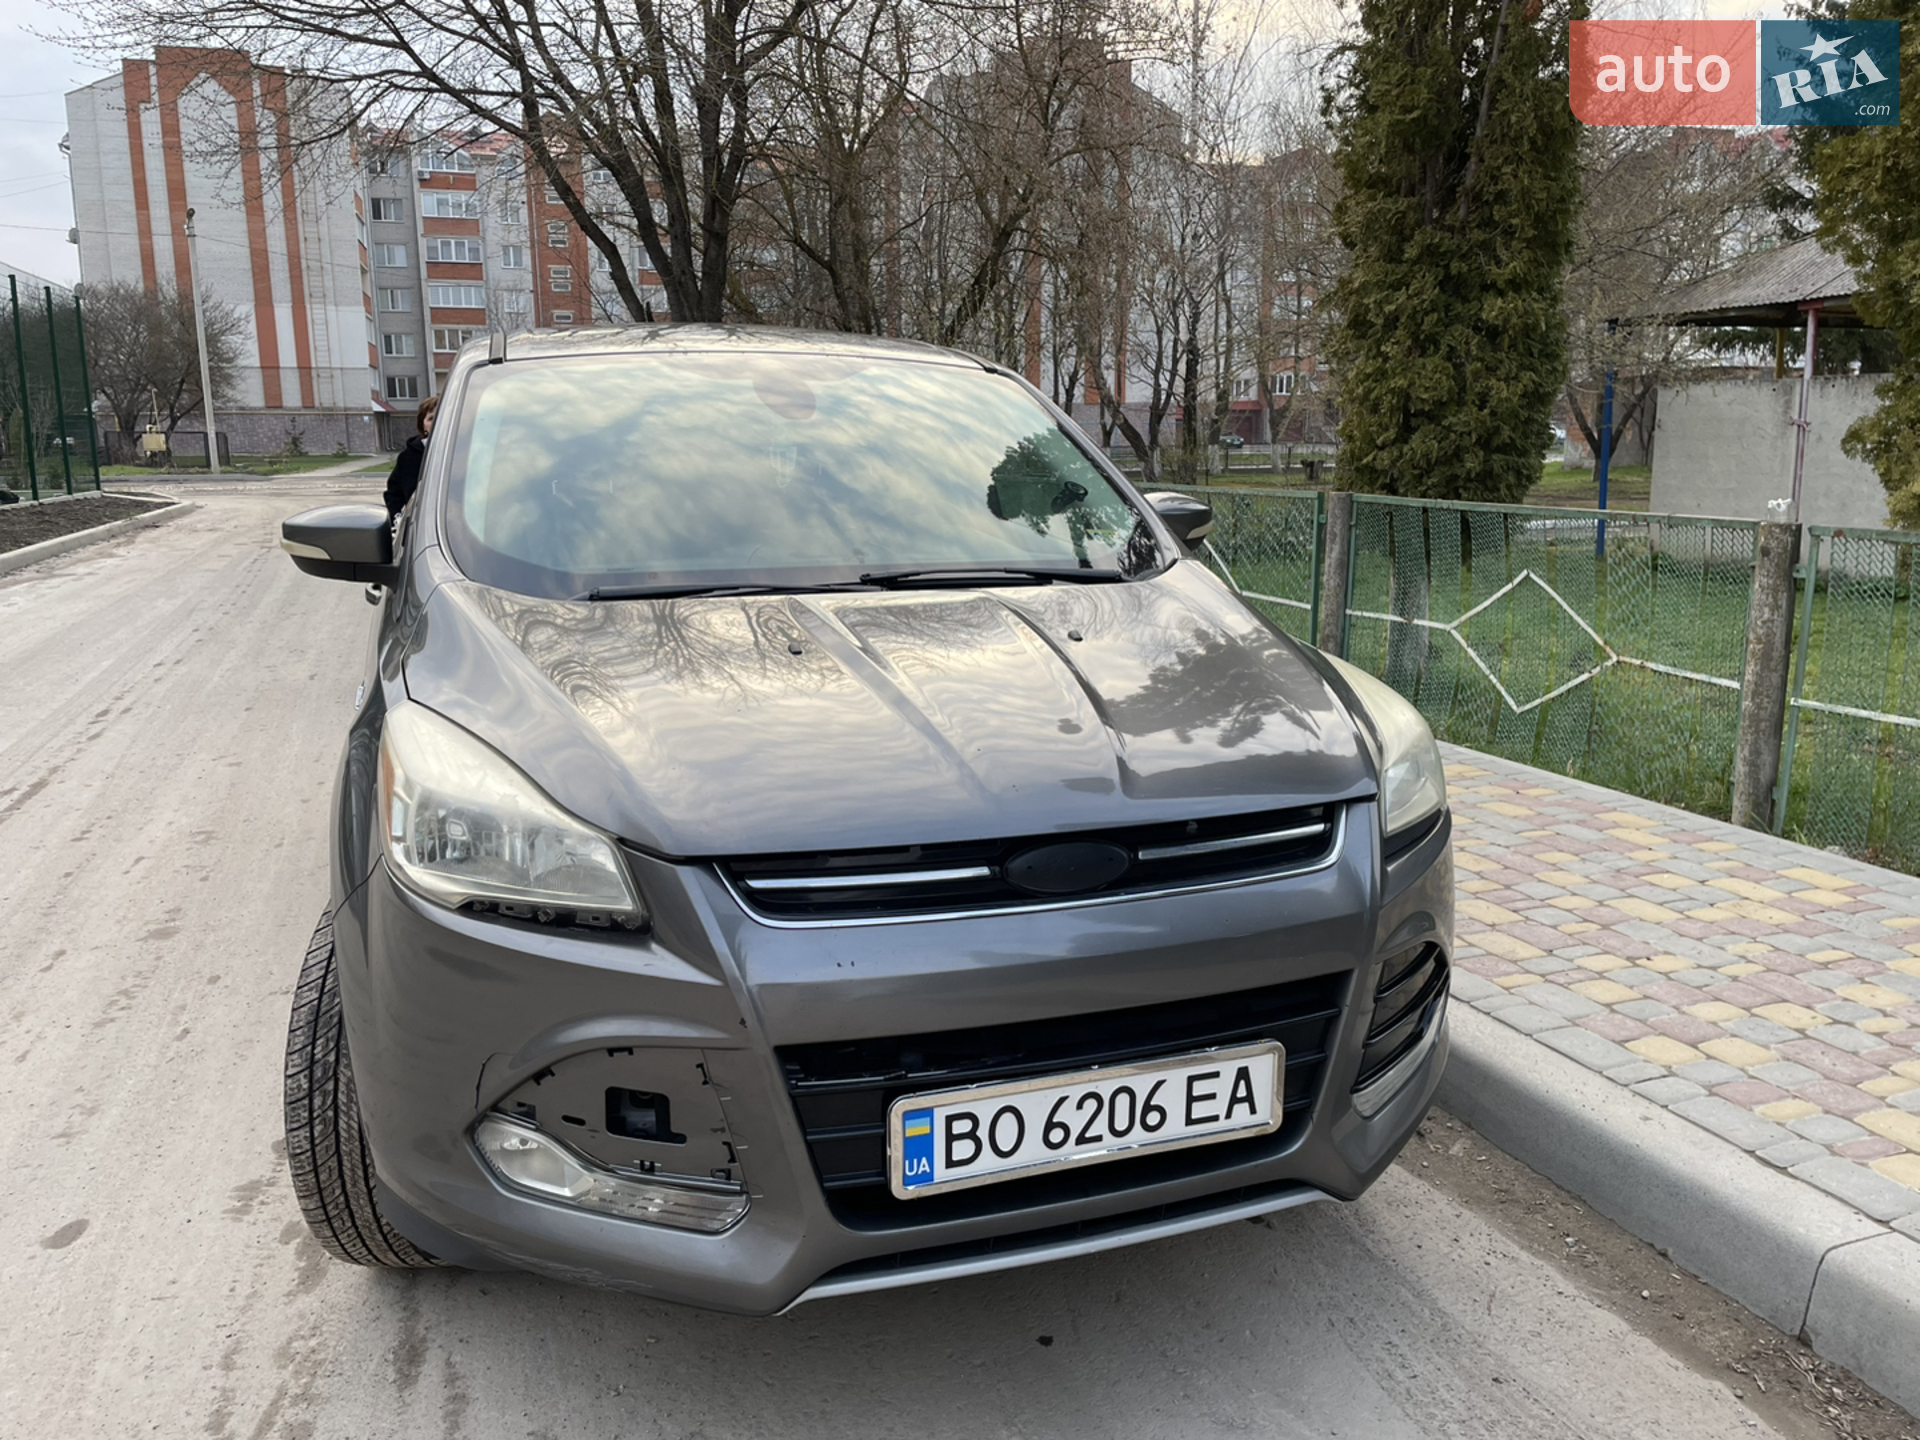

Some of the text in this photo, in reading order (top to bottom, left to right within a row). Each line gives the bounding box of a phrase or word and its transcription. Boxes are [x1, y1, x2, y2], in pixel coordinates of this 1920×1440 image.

[944, 1065, 1258, 1170] BO 6206 EA
[904, 1156, 931, 1177] UA
